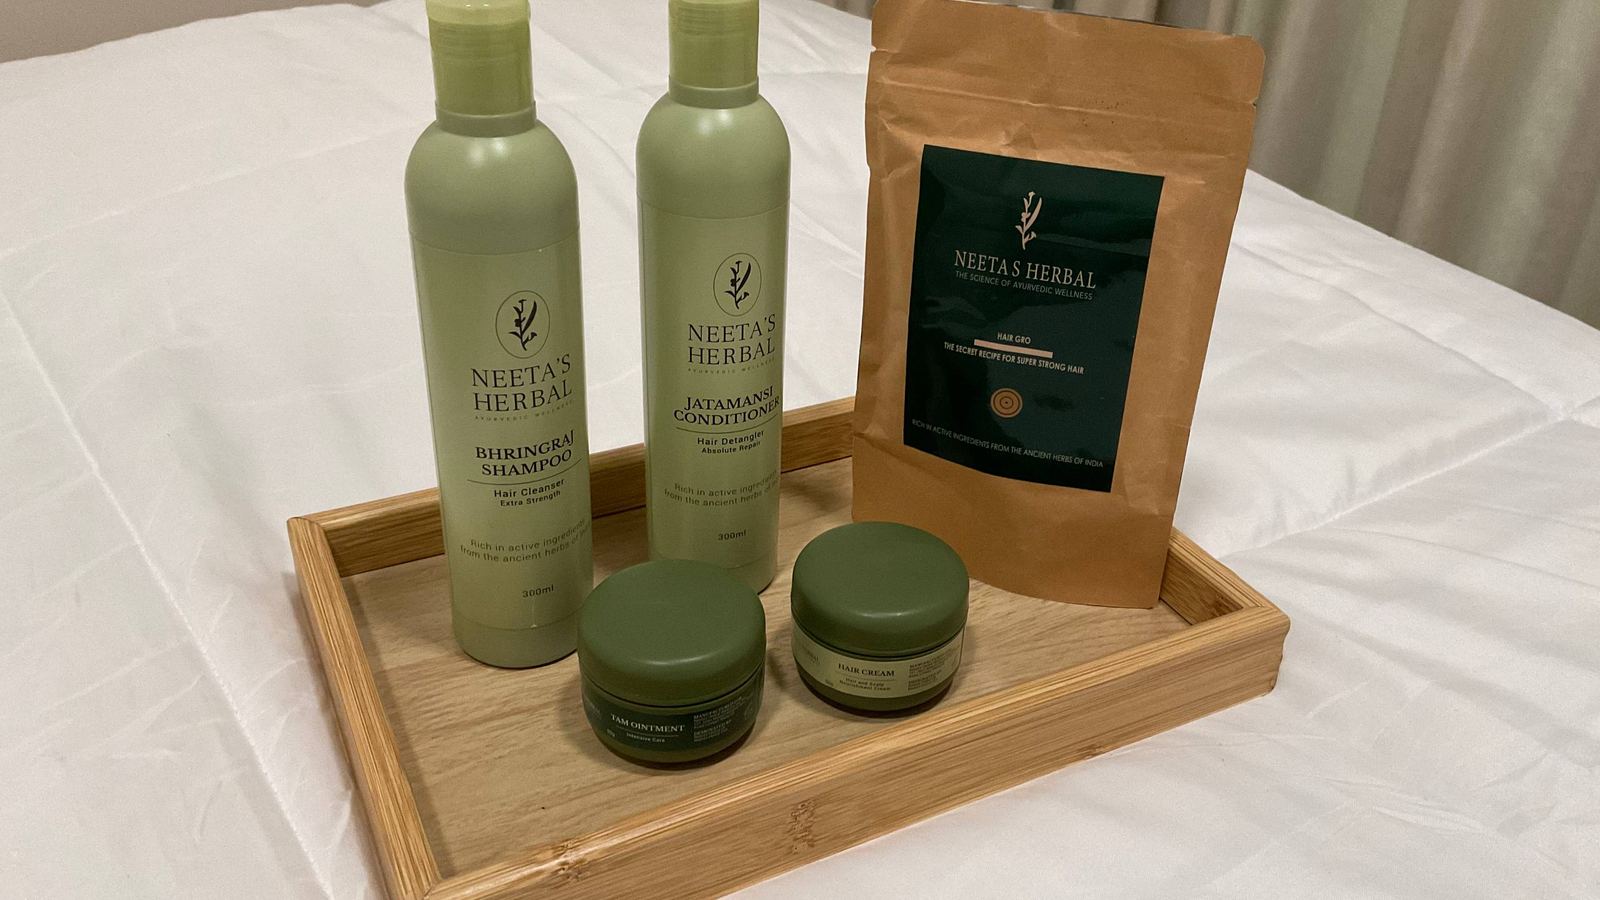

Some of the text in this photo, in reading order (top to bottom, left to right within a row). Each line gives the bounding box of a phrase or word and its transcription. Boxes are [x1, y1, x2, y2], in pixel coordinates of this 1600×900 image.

[955, 270, 1093, 300] THE SCIENCE OF AYURVEDIC WELLNESS
[1026, 262, 1097, 289] HERBAL
[688, 313, 776, 343] NEETA'S
[997, 331, 1031, 344] HAIR GRO
[688, 337, 775, 365] HERBAL
[944, 341, 1084, 375] THE SECRET RECIPE FOR SUPER STRONG HAIR
[471, 354, 571, 388] NEETA'S
[473, 379, 572, 412] HERBAL
[684, 385, 774, 411] JATAMANSI
[674, 395, 780, 426] CONDITIONER
[475, 430, 574, 461] BHRINGRAJ
[697, 430, 764, 446] Hair Detangler
[701, 440, 761, 454] Absolute Repair
[932, 425, 952, 438] ACTIVE
[953, 432, 990, 449] INGREDIENTS
[990, 442, 1010, 453] FROM
[1011, 446, 1022, 455] THE
[1023, 448, 1052, 460] ANCIENT
[1052, 453, 1073, 464] HERBS
[1073, 457, 1084, 465] OF
[1085, 459, 1104, 468] INDIA
[482, 449, 572, 476] SHAMPOO
[494, 479, 565, 498] Hair Cleanser
[500, 490, 561, 507] Extra Strength
[708, 487, 737, 497] active
[685, 497, 700, 506] the
[702, 496, 738, 507] ancient
[718, 529, 747, 541] 300ml
[460, 545, 480, 559] from
[483, 553, 500, 562] the
[503, 551, 542, 563] ancient
[496, 543, 505, 552] in
[509, 541, 540, 552] active
[522, 584, 554, 598] 300ml
[838, 663, 895, 677] HAIR CREAM
[611, 713, 629, 727] TAM
[630, 721, 685, 733] OINTMENT
